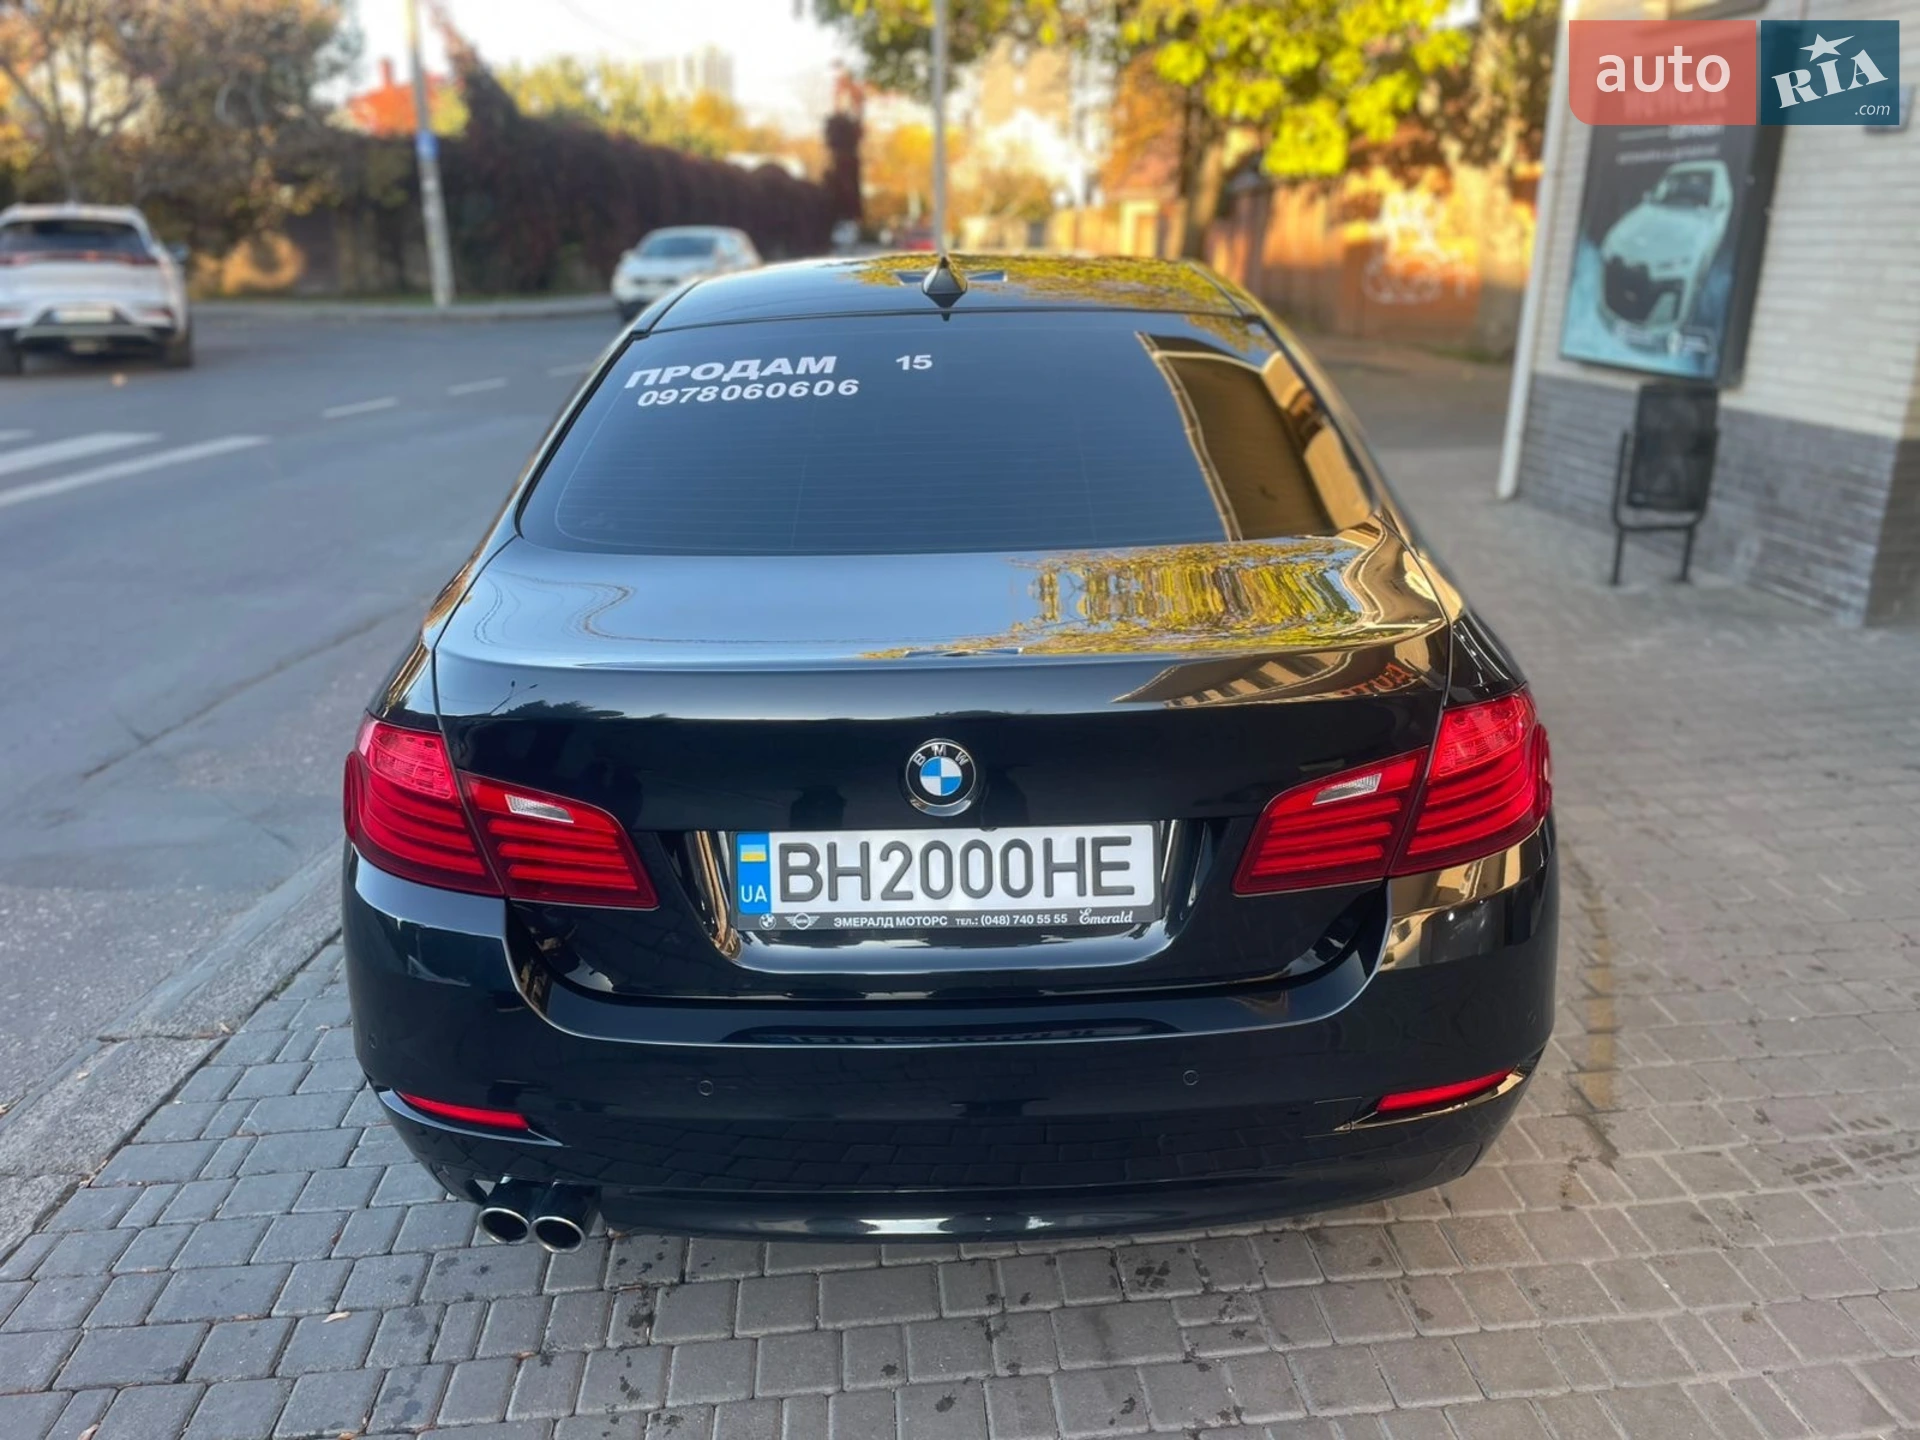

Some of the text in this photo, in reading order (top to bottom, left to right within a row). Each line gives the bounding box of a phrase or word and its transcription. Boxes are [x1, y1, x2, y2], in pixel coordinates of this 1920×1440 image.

[624, 356, 837, 388] ПРОДАМ
[896, 354, 933, 370] 15
[637, 379, 860, 407] 0978060606
[913, 741, 970, 767] BMW
[779, 836, 1135, 903] BH2000HE
[741, 887, 768, 904] UA
[833, 917, 893, 928] ЭМЕРАЛД
[895, 916, 948, 926] МОТОРС
[980, 914, 1010, 926] (048)
[1013, 915, 1034, 925] 740
[1036, 914, 1050, 924] 55
[1053, 914, 1068, 924] 55
[1079, 908, 1134, 924] Emerald
